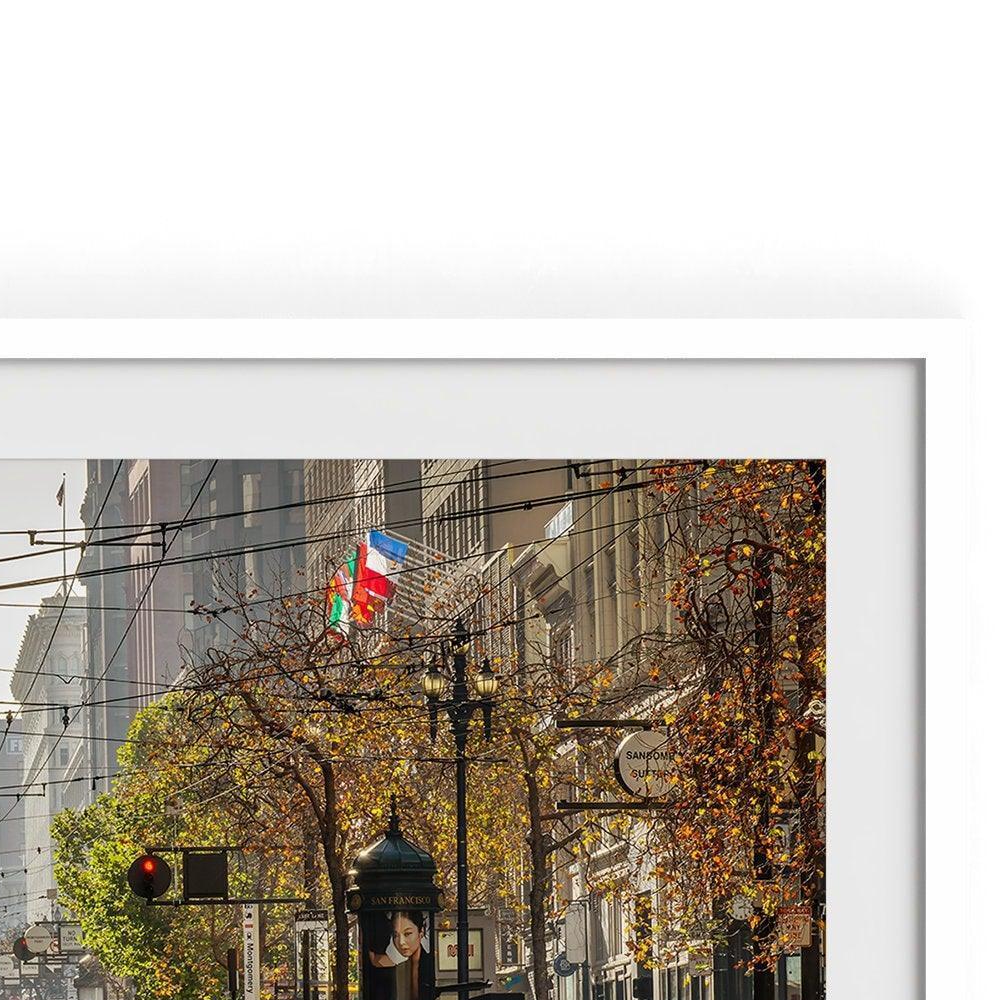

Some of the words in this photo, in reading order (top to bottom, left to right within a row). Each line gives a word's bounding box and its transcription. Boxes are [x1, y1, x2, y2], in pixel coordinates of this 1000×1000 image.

[371, 896, 388, 905] SAN
[389, 896, 431, 905] FRANCISCO
[246, 943, 254, 994] Montgomery
